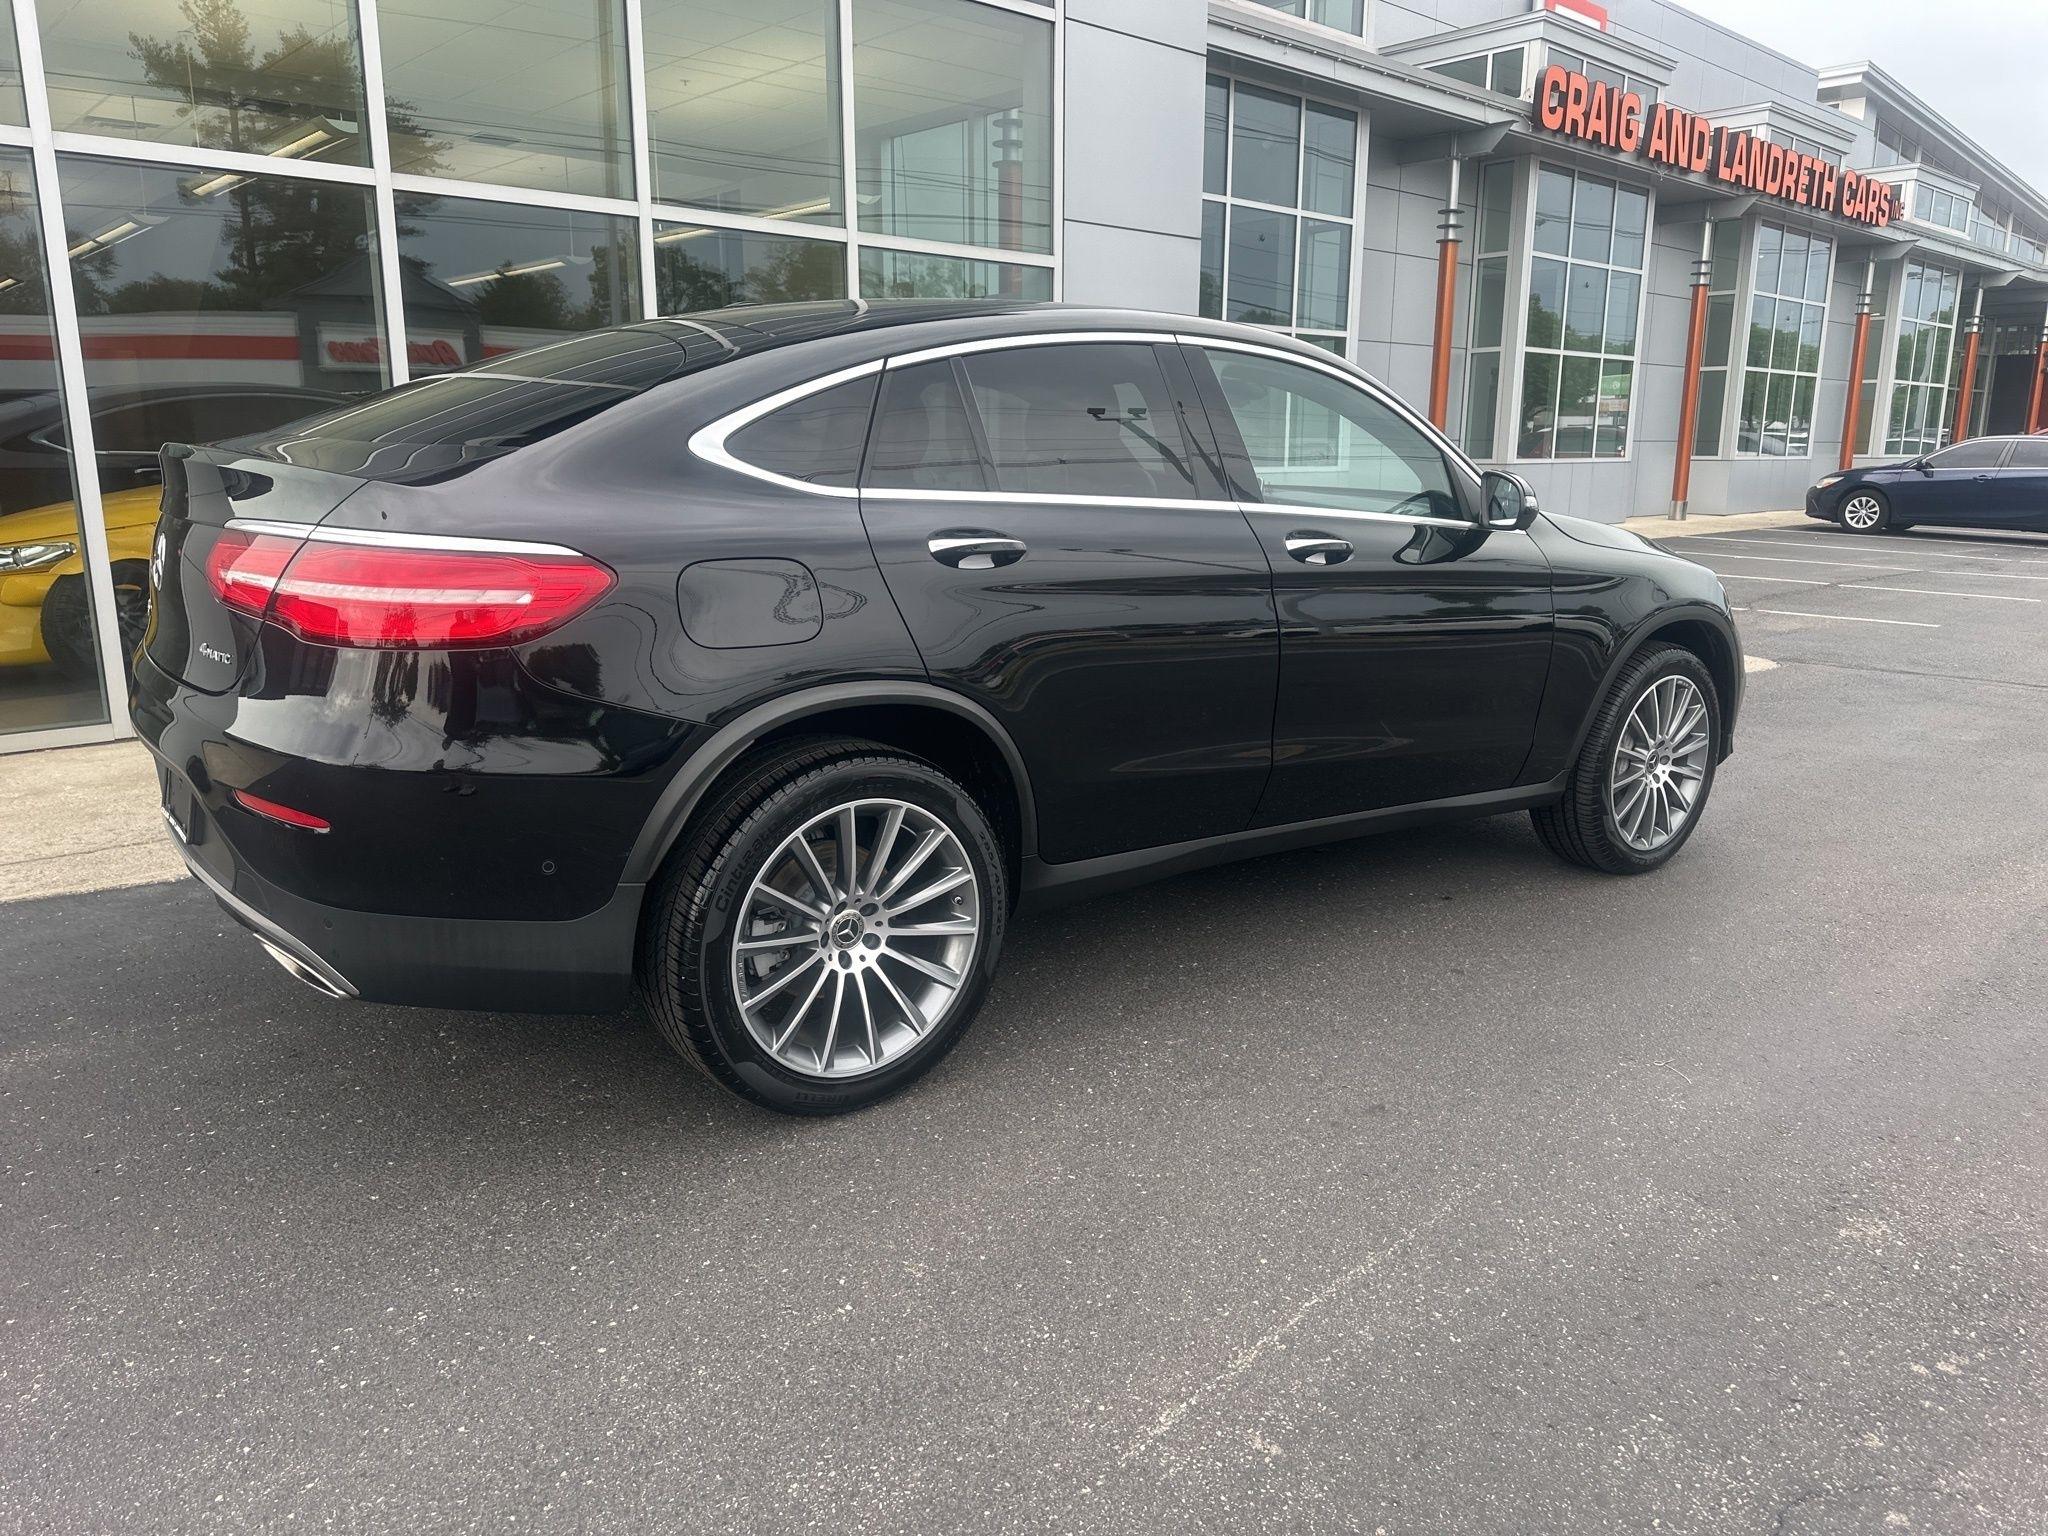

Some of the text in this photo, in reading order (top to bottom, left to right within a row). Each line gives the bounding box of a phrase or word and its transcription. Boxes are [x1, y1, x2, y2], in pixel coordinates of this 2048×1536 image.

[1541, 65, 1640, 152] CRAIG
[1648, 103, 1710, 172] AND
[1718, 126, 1838, 212] LANDRETH
[1843, 170, 1890, 227] CARS
